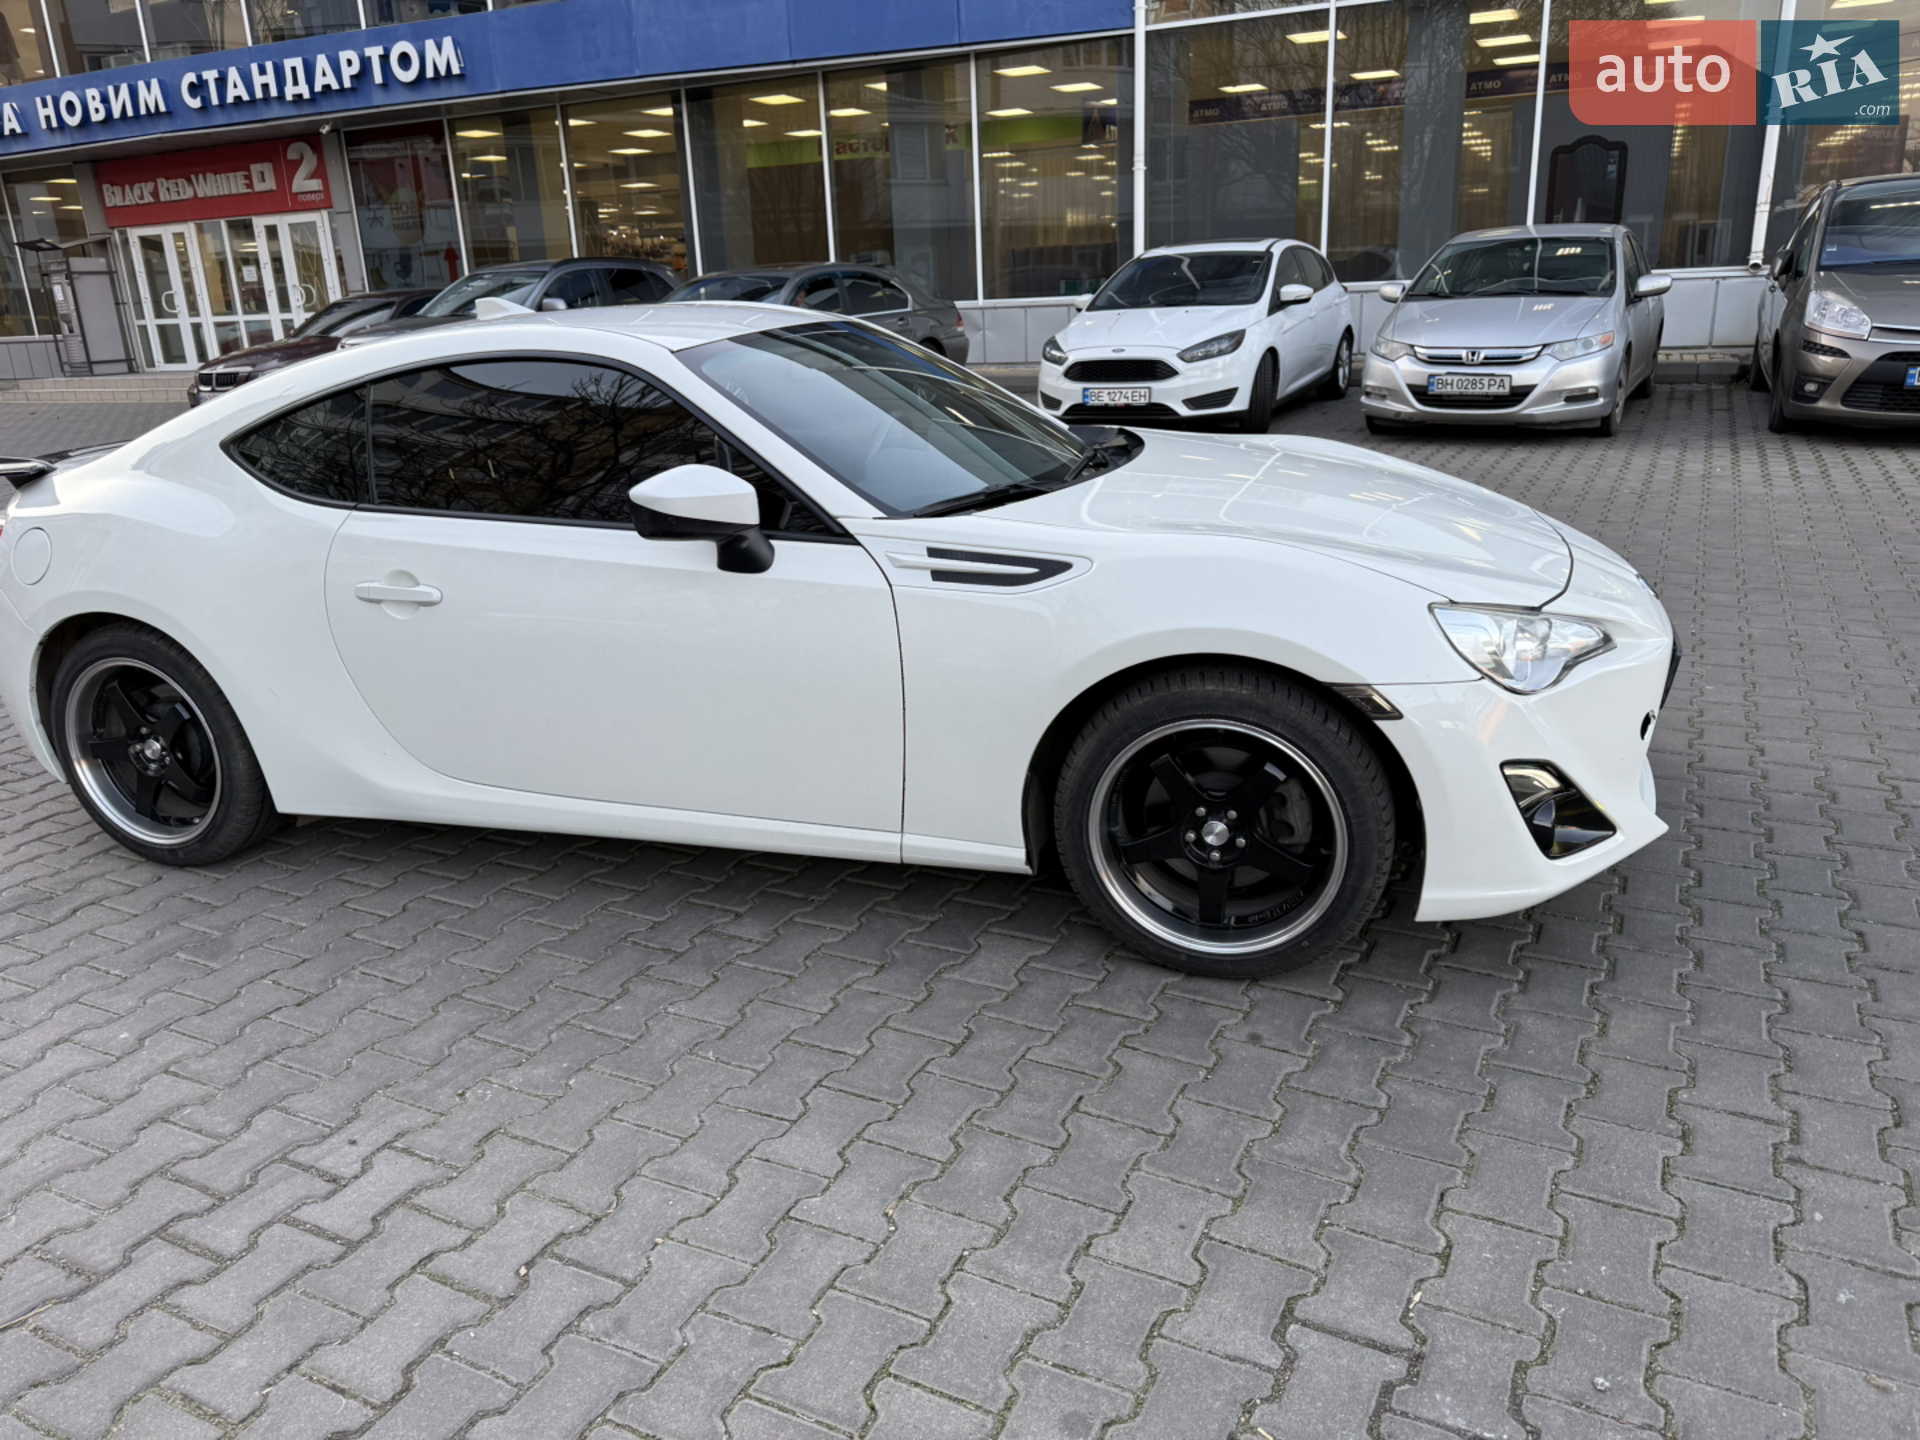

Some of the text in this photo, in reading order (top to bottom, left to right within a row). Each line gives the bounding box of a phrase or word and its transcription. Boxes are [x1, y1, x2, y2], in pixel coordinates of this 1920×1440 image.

[2, 35, 463, 136] А НОВИМ СТАНДАРТОМ
[286, 141, 324, 194] 2
[102, 170, 253, 208] BLACK RED WHITE
[297, 191, 325, 204] поверх
[1090, 390, 1148, 402] BE 1274 EH
[1436, 378, 1507, 390] BH 0285 PA
